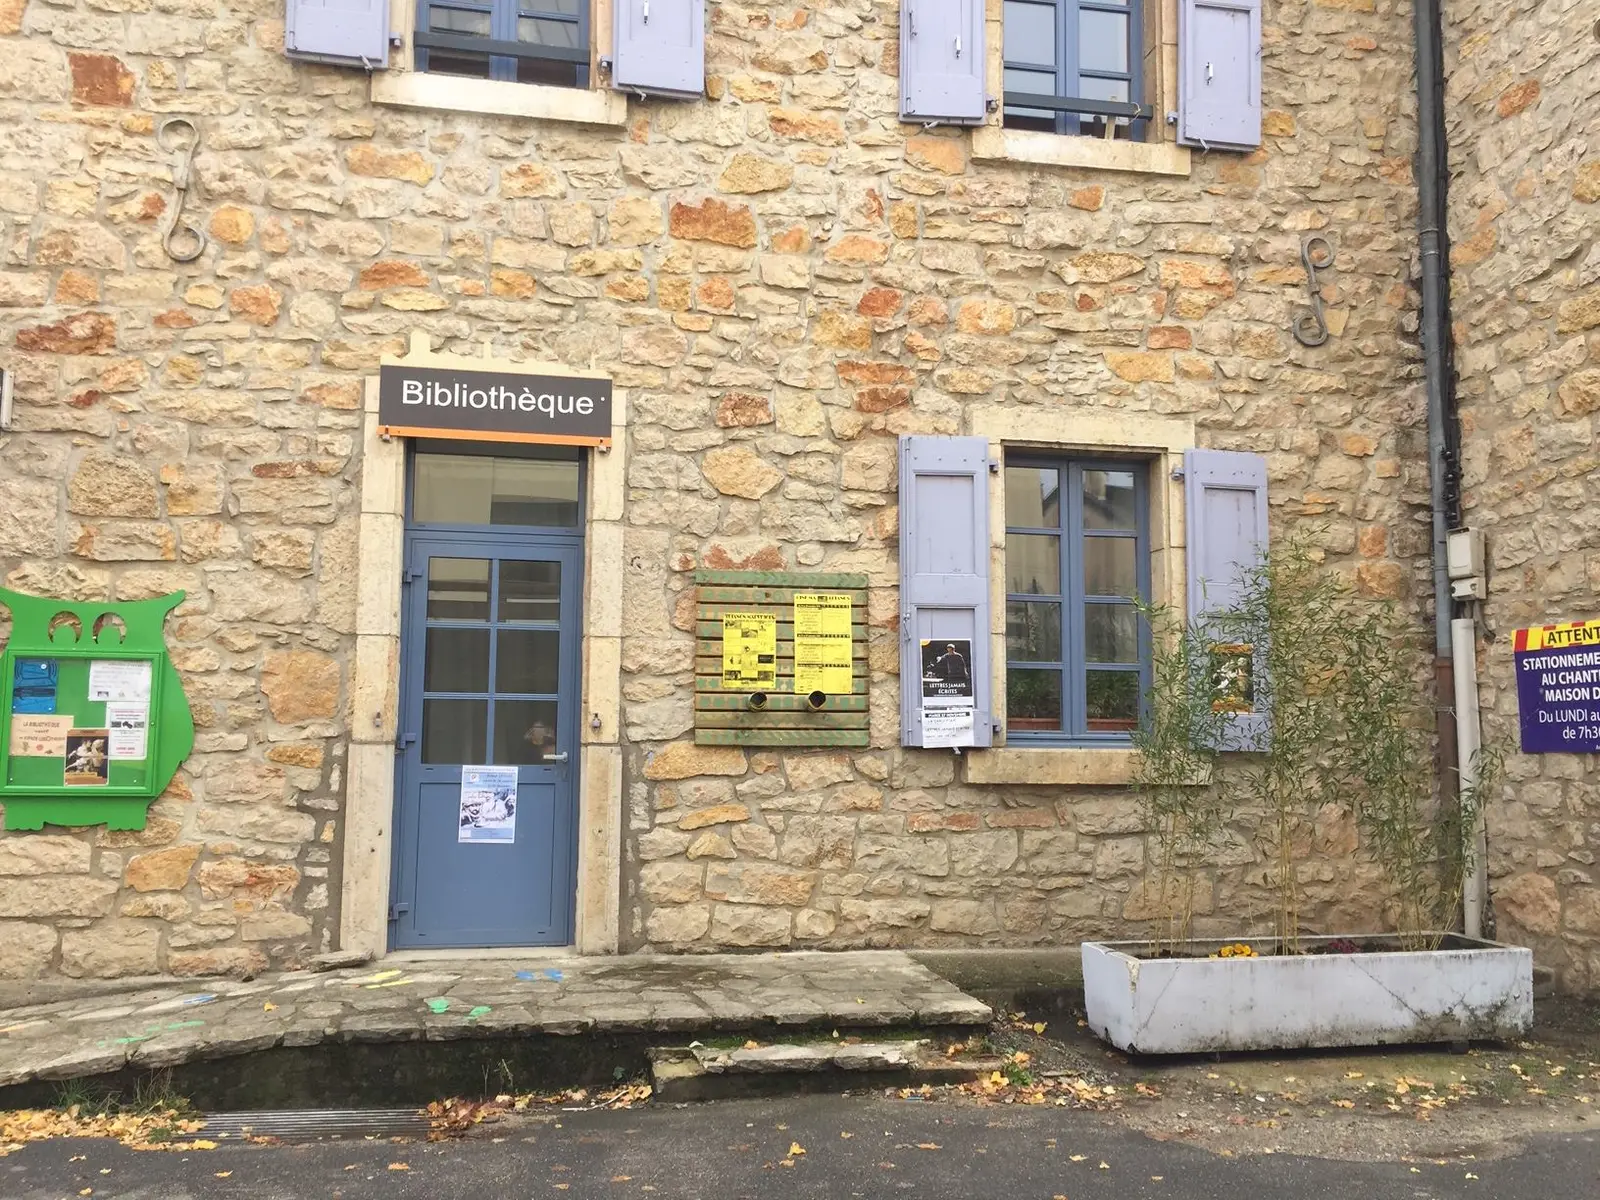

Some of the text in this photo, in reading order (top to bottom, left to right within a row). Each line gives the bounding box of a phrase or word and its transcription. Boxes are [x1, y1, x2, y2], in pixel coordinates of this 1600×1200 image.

[402, 379, 594, 418] Bibliothèque
[1548, 627, 1600, 644] ATTENT
[1523, 653, 1600, 670] STATIONNEME
[1542, 673, 1556, 685] AU
[1545, 687, 1590, 702] MAISON
[1538, 710, 1553, 723] Du
[1555, 708, 1588, 722] LUNDI
[1562, 725, 1600, 739] de 7h3
